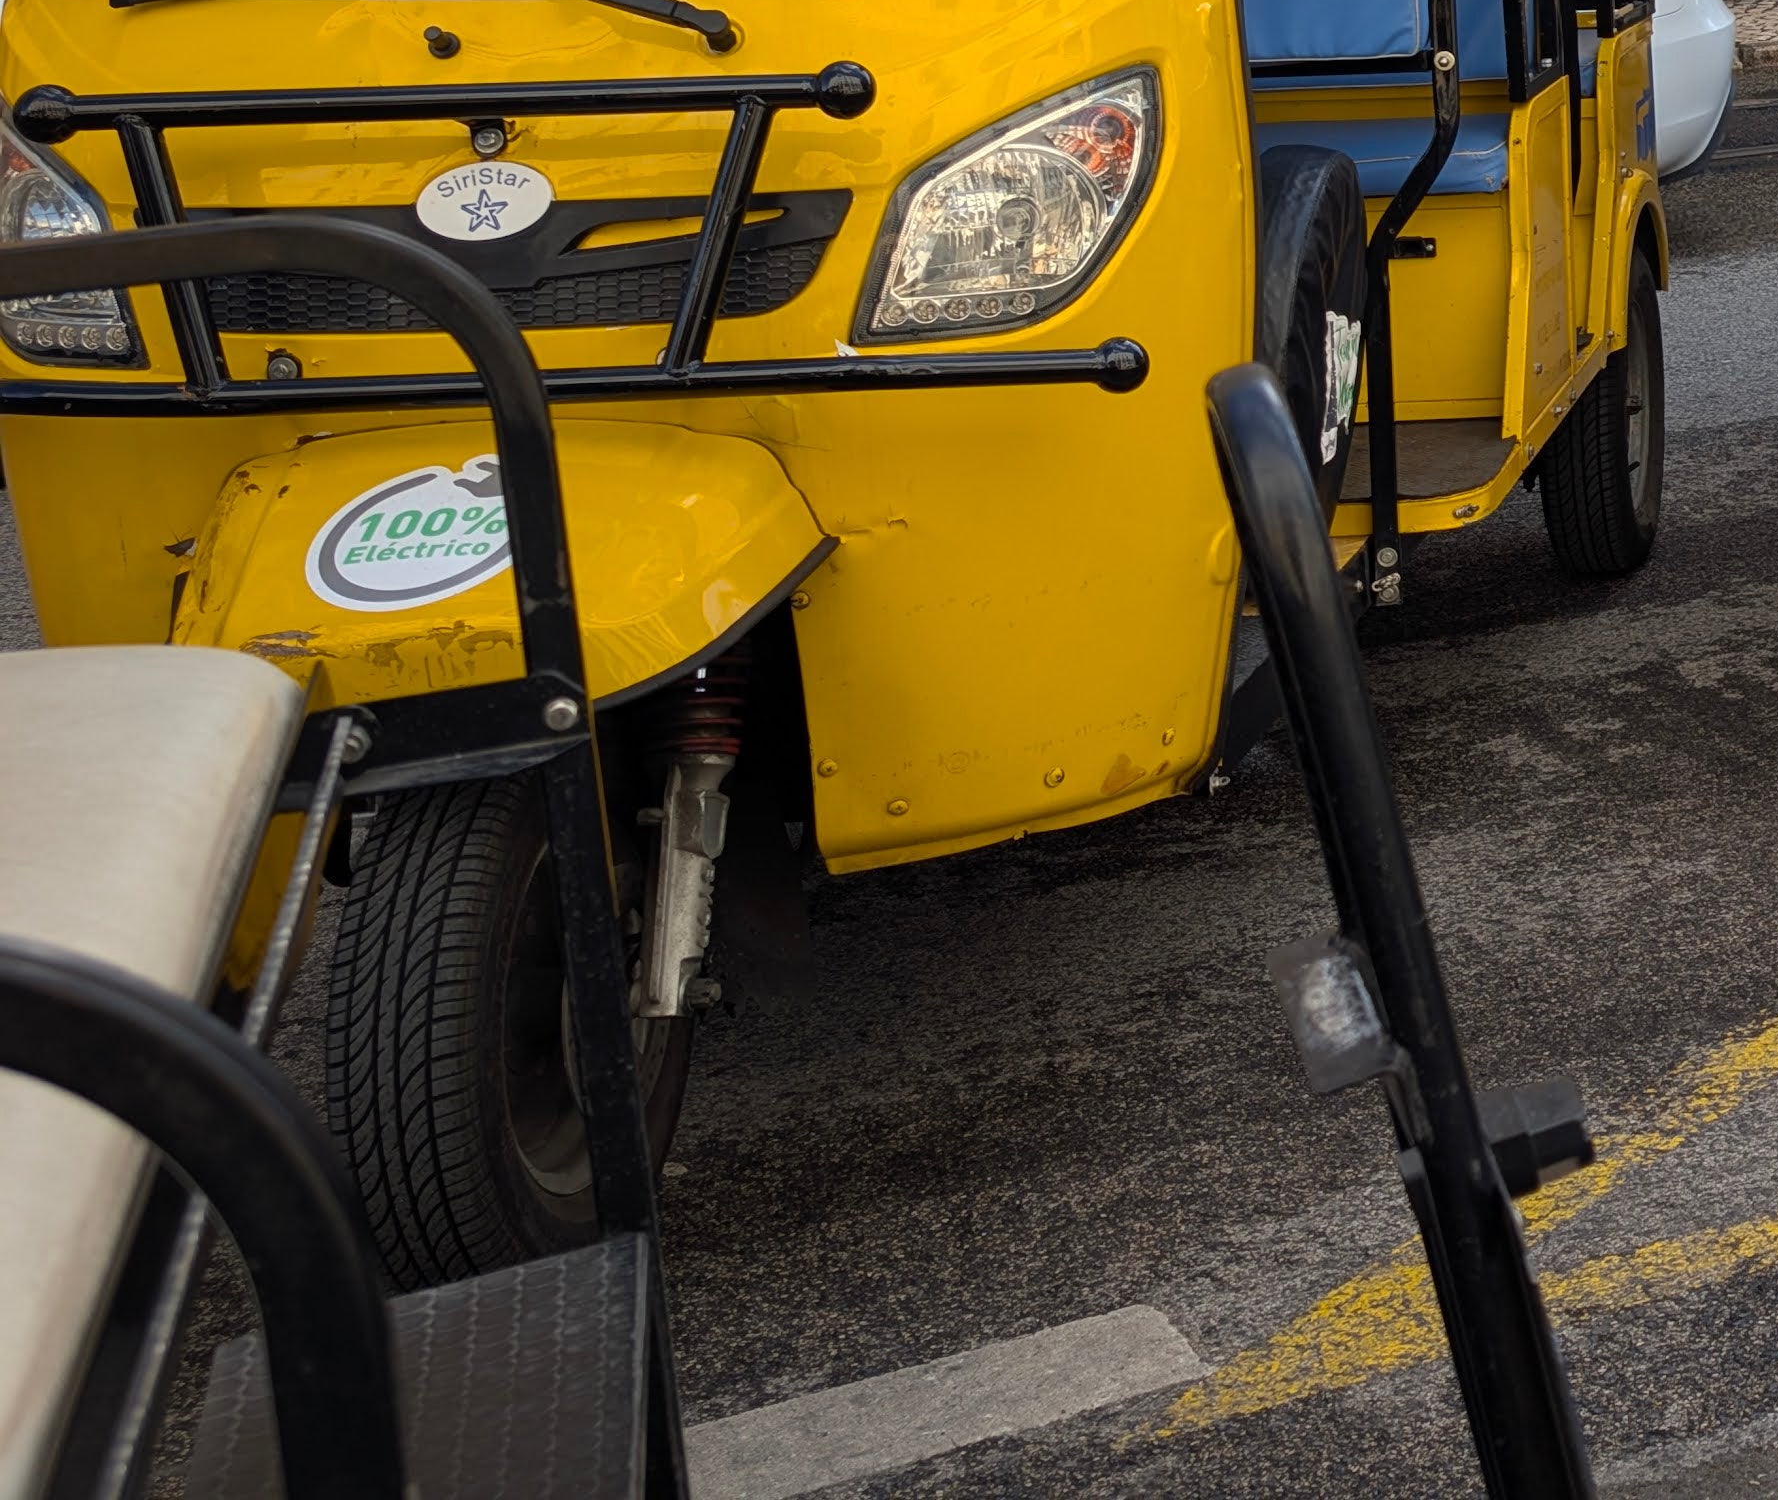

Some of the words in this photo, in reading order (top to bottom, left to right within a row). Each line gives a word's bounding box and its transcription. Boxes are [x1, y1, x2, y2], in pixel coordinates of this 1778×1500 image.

[436, 167, 532, 199] SiriStar
[358, 505, 509, 543] 100%
[342, 533, 492, 567] Eléctrico
